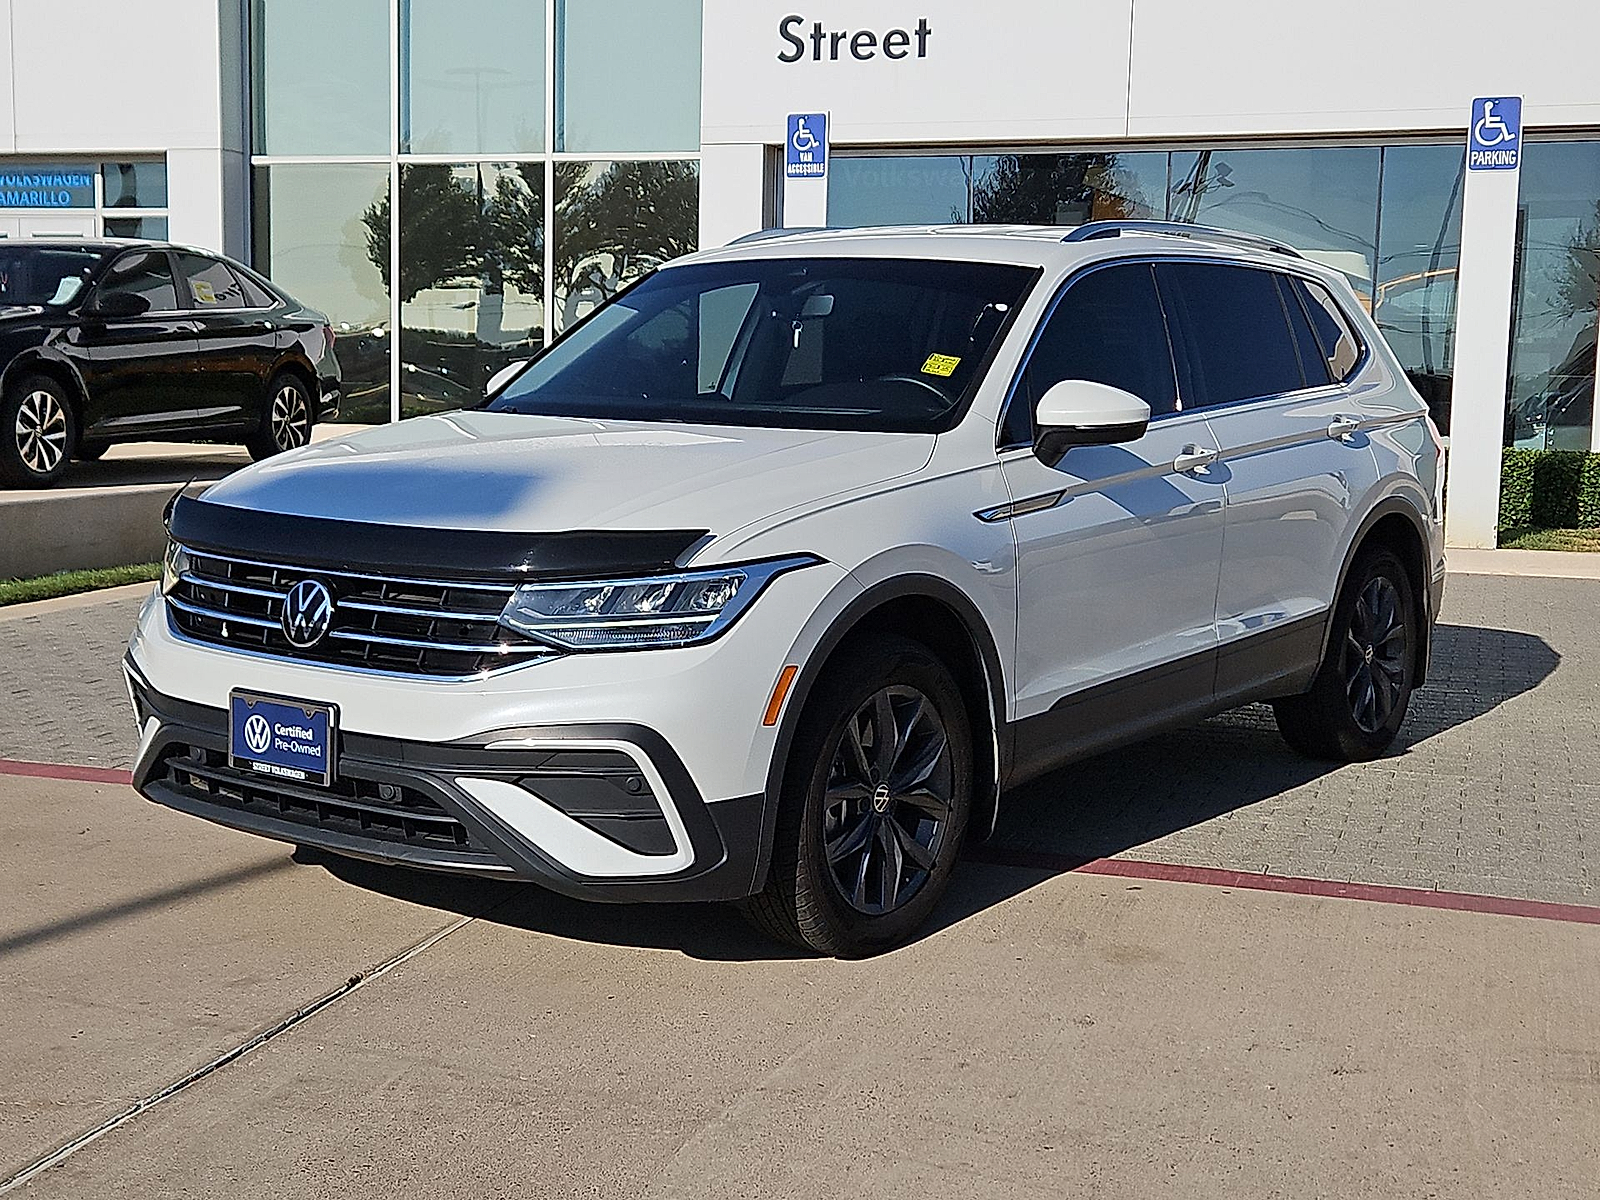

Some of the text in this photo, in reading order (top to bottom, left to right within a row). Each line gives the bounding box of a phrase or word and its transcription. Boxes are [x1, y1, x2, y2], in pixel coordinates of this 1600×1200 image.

[777, 14, 932, 63] Street
[799, 151, 813, 163] VAN
[1470, 149, 1517, 166] PARKING
[787, 163, 825, 174] ACCESSIBLE
[0, 190, 71, 205] AMARILLO
[274, 722, 314, 741] Certified
[274, 738, 322, 757] Pre-Owned
